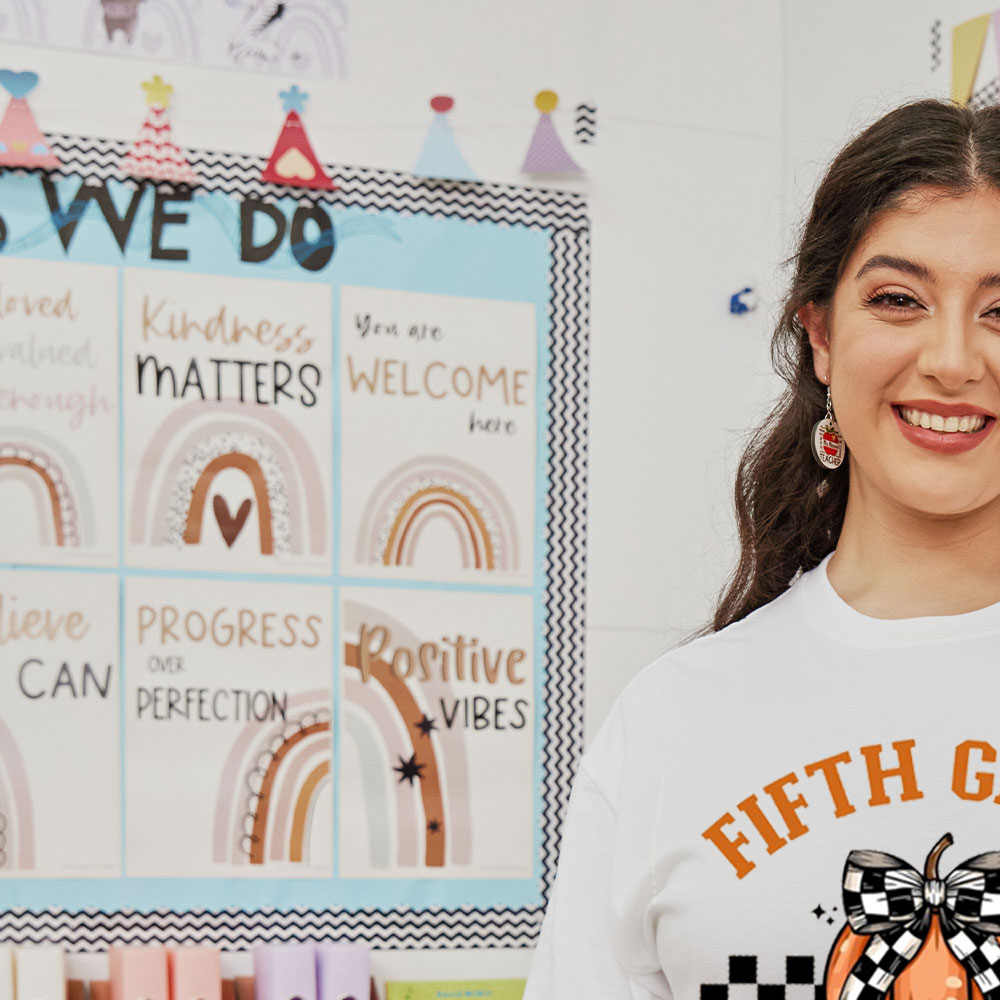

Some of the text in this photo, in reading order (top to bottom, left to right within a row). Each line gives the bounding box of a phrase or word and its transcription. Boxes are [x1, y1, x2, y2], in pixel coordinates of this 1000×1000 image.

[40, 174, 192, 261] WE
[240, 197, 335, 271] DO
[142, 296, 316, 354] Kindness
[356, 314, 443, 341] You are
[137, 354, 321, 407] MATTERS
[347, 355, 529, 406] WELCOME
[469, 411, 517, 435] here
[137, 605, 323, 648] PROGRESS
[148, 655, 186, 674] OVER
[360, 623, 527, 684] Positive
[18, 657, 113, 699] CAN
[137, 686, 288, 722] PERFECTION
[439, 696, 529, 731] VIBES
[702, 739, 923, 880] FIFTH
